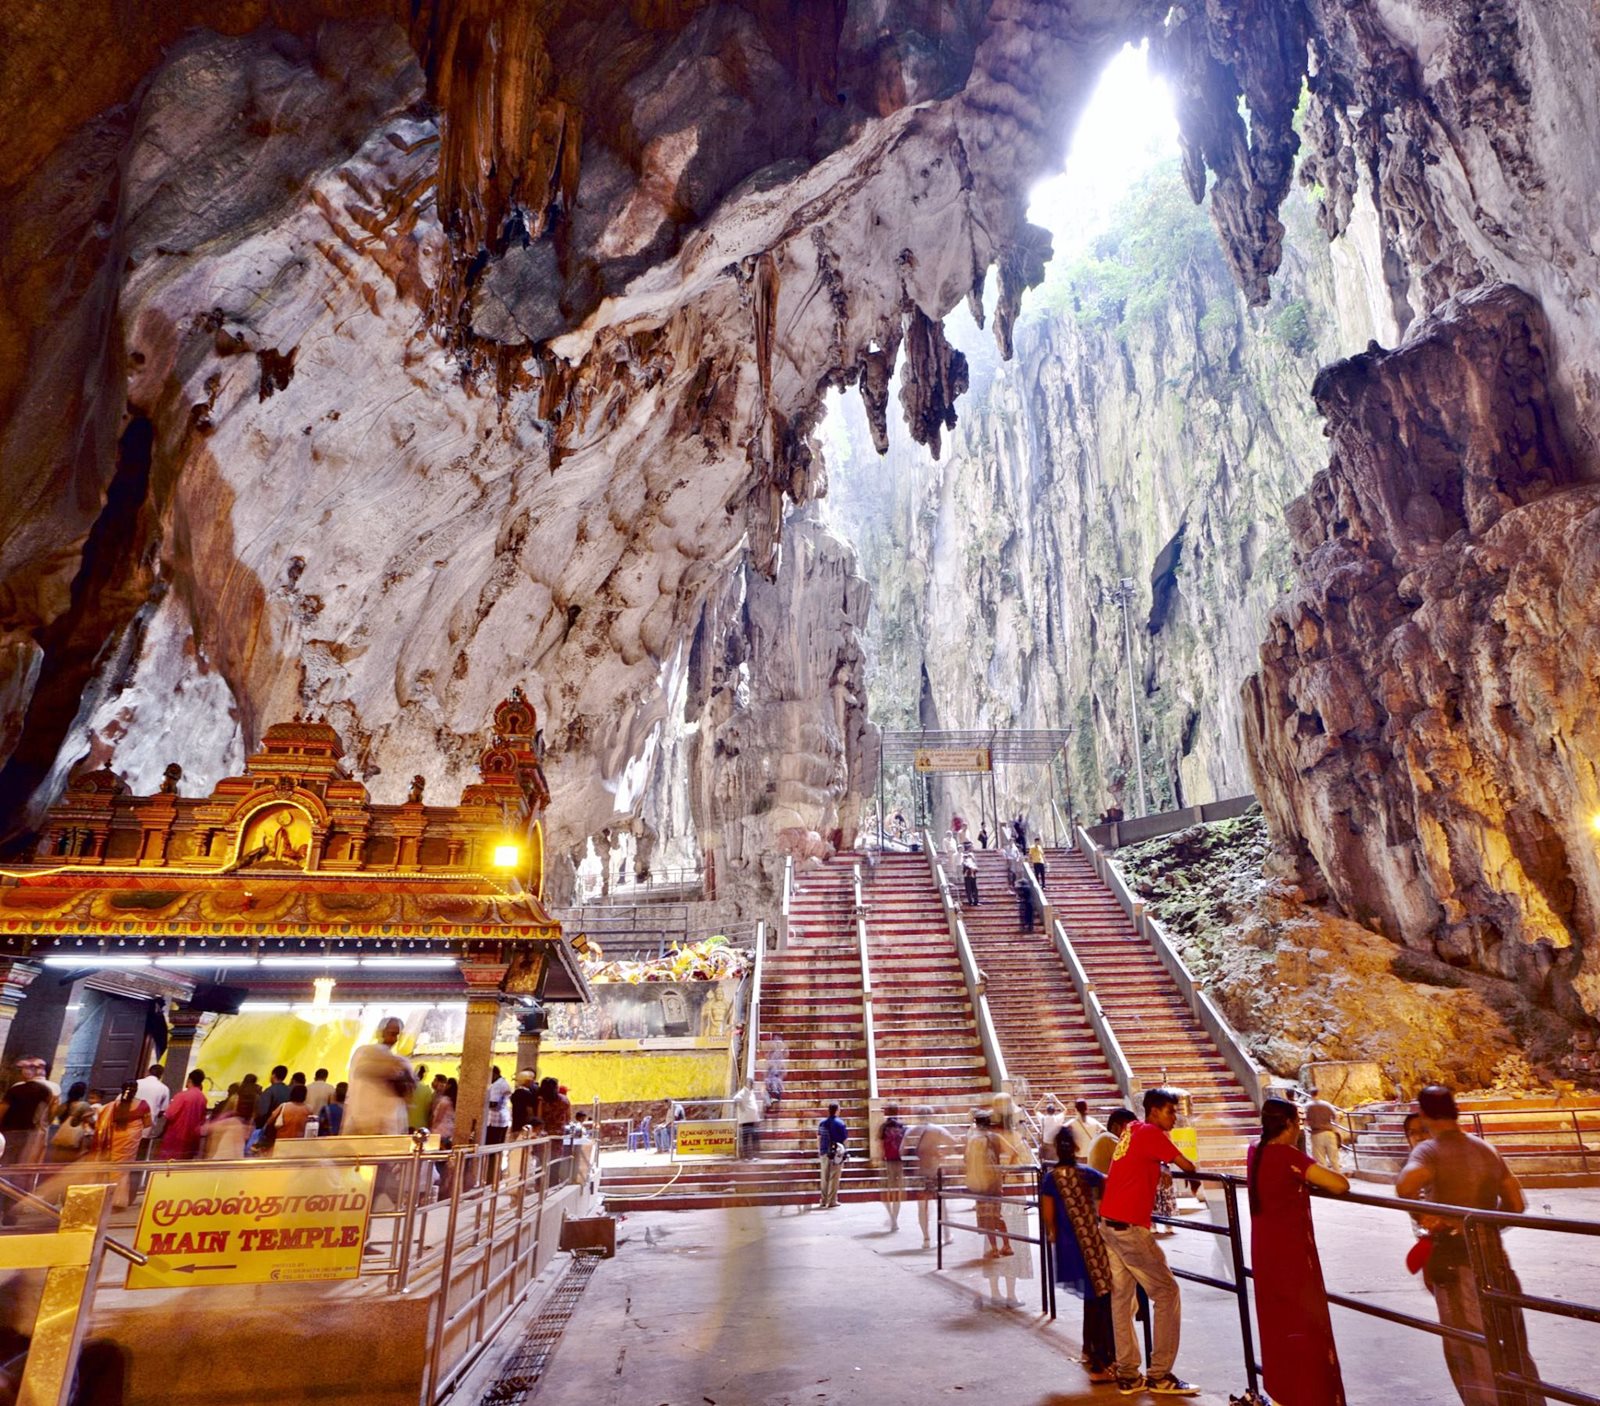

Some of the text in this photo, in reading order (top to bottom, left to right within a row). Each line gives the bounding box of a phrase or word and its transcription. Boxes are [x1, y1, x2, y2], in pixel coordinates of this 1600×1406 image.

[681, 1138, 701, 1146] MAIN
[152, 1189, 366, 1226] மூலஸ்தானம்
[148, 1226, 359, 1255] MAIN TEMPLE
